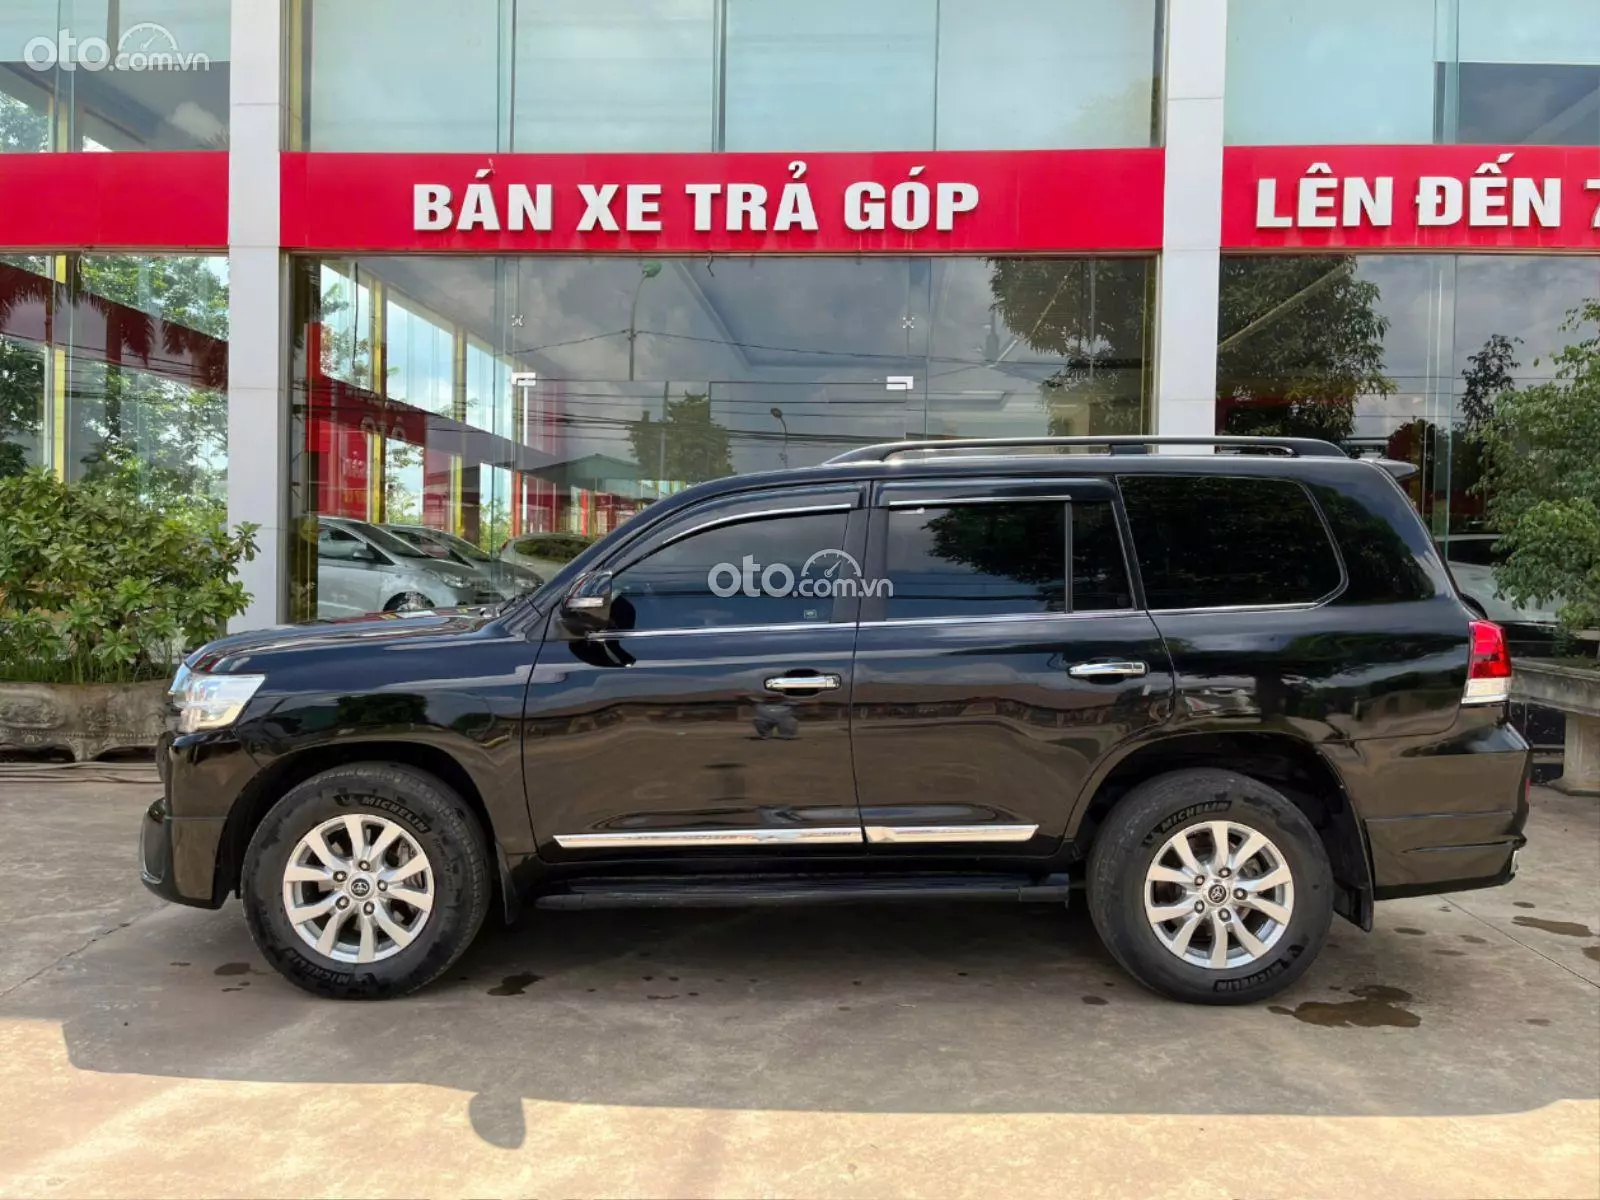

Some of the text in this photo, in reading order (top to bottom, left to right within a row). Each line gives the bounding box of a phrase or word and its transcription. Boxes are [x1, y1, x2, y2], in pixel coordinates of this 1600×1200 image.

[413, 160, 979, 231] BÁN XE TRẢ GÓP
[1256, 162, 1394, 228] LÊN
[1415, 152, 1562, 227] ĐẾN
[361, 795, 430, 832] MICHELIN
